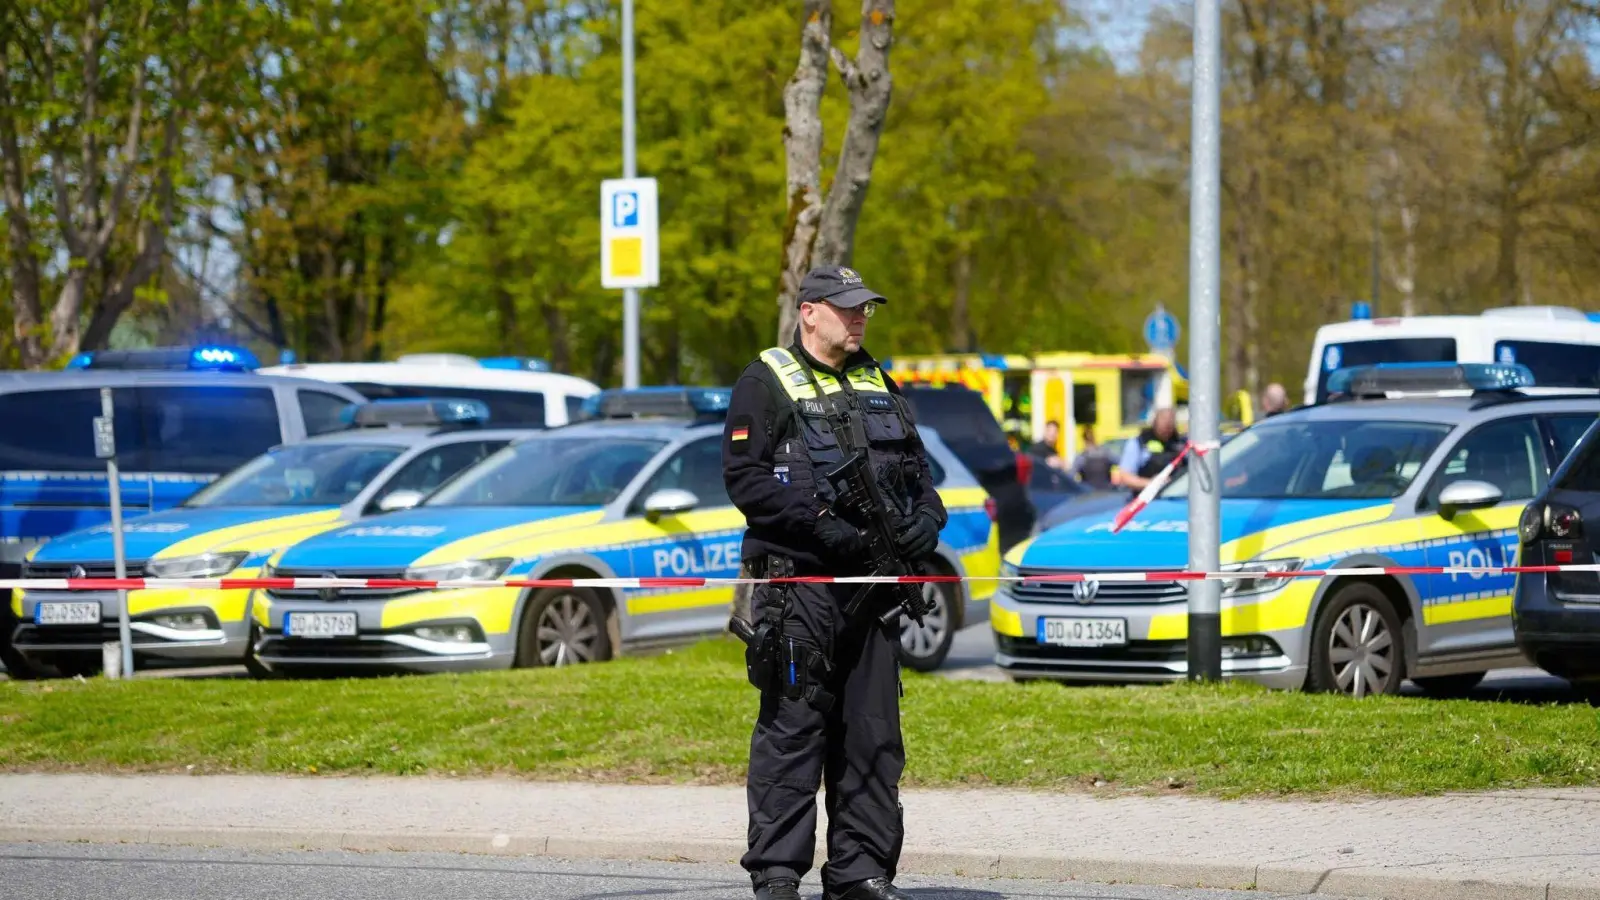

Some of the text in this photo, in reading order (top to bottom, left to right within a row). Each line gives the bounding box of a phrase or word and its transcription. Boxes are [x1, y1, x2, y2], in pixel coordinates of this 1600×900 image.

[616, 192, 636, 227] P
[653, 541, 741, 577] POLIZE
[1047, 622, 1065, 639] DD
[1087, 622, 1122, 639] 1364
